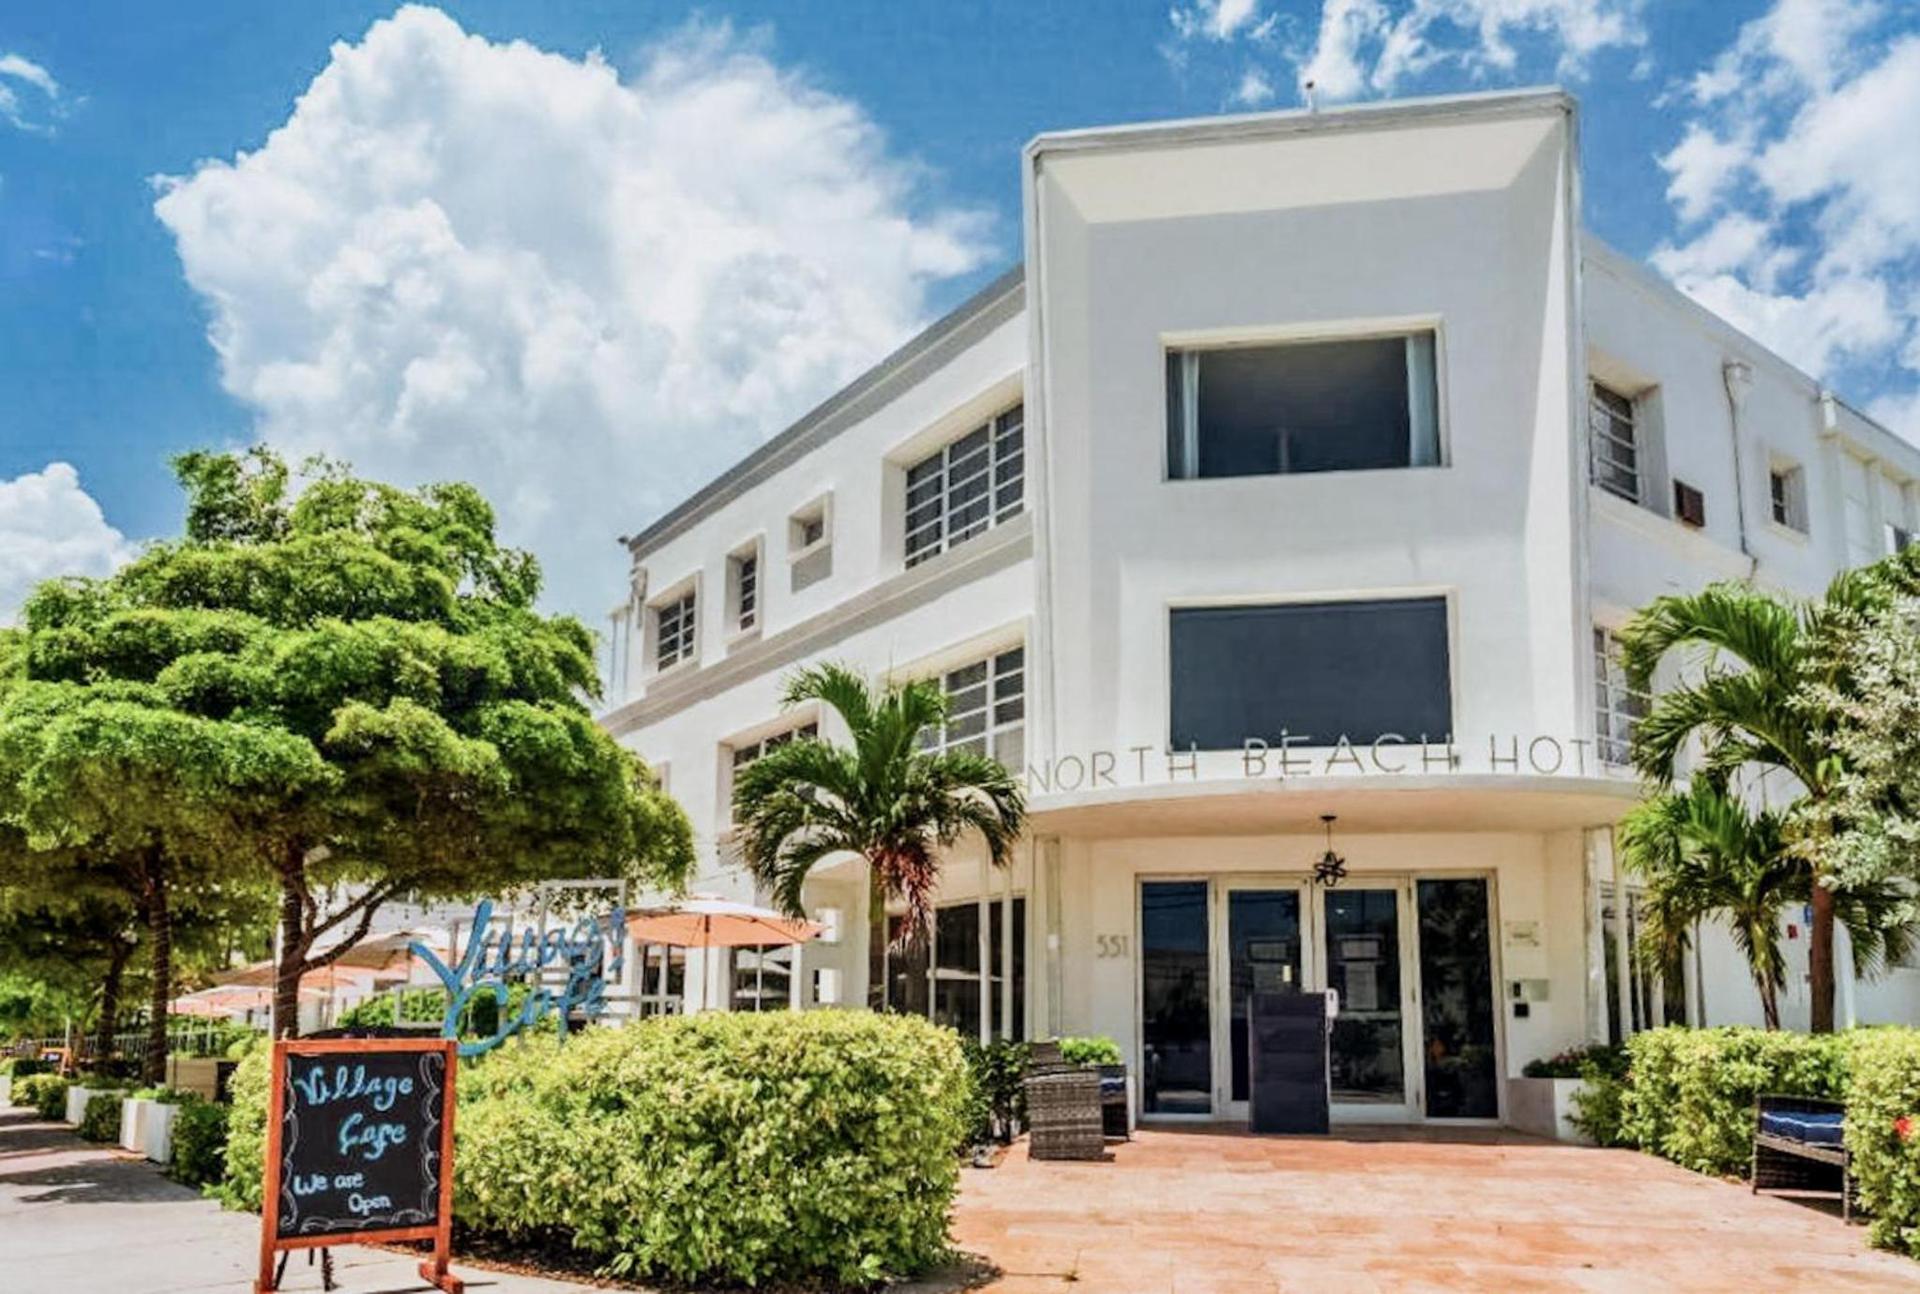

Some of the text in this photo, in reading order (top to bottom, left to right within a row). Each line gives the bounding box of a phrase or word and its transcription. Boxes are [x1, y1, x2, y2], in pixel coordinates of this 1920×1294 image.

[1027, 743, 1199, 793] NORTH
[1242, 733, 1457, 776] BEACH
[1096, 934, 1129, 958] 551
[294, 1064, 415, 1111] Village
[338, 1112, 408, 1160] Cafe
[293, 1172, 366, 1195] We are
[347, 1193, 392, 1216] Open
